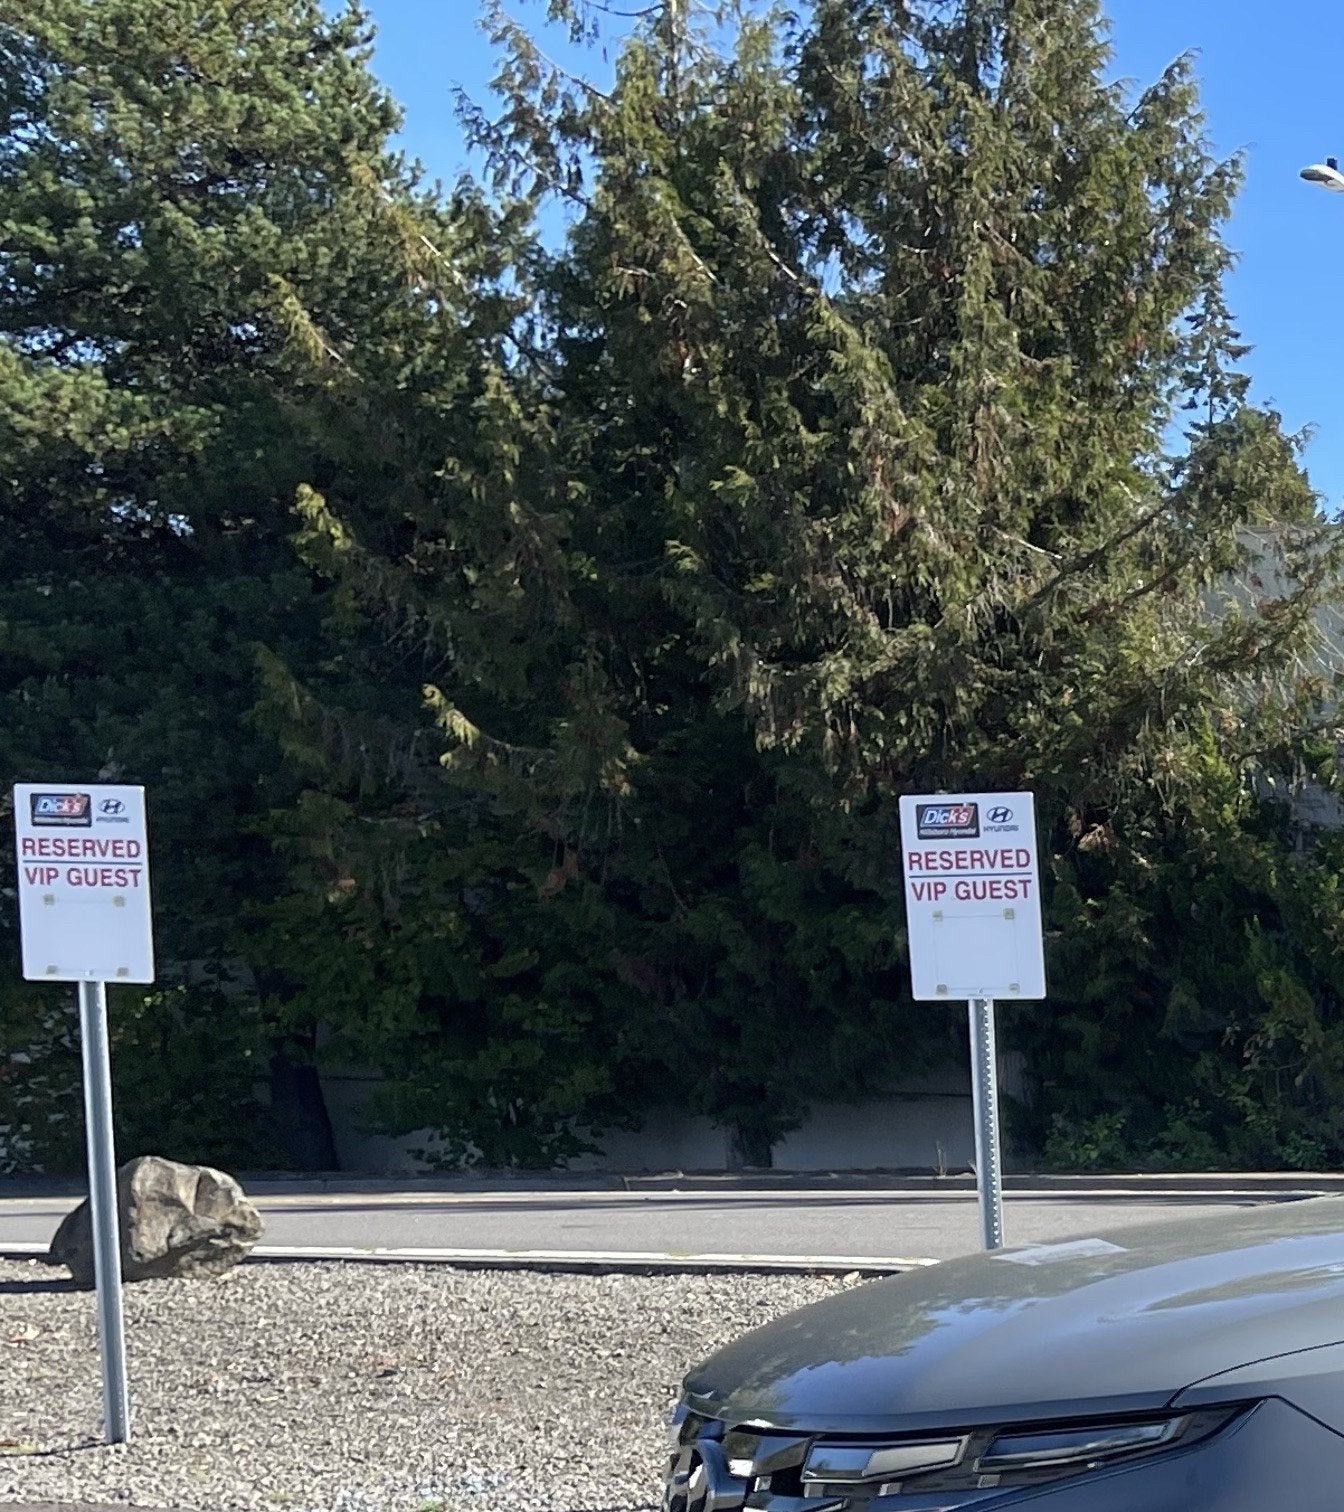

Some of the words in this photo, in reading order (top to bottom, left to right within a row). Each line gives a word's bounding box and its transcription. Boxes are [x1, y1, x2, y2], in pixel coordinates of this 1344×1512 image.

[22, 838, 141, 858] RESERVED
[908, 849, 1031, 870] RESERVED
[24, 867, 59, 886] VIP
[66, 868, 142, 888] GUEST
[911, 881, 947, 901] VIP
[955, 879, 1032, 901] GUEST
